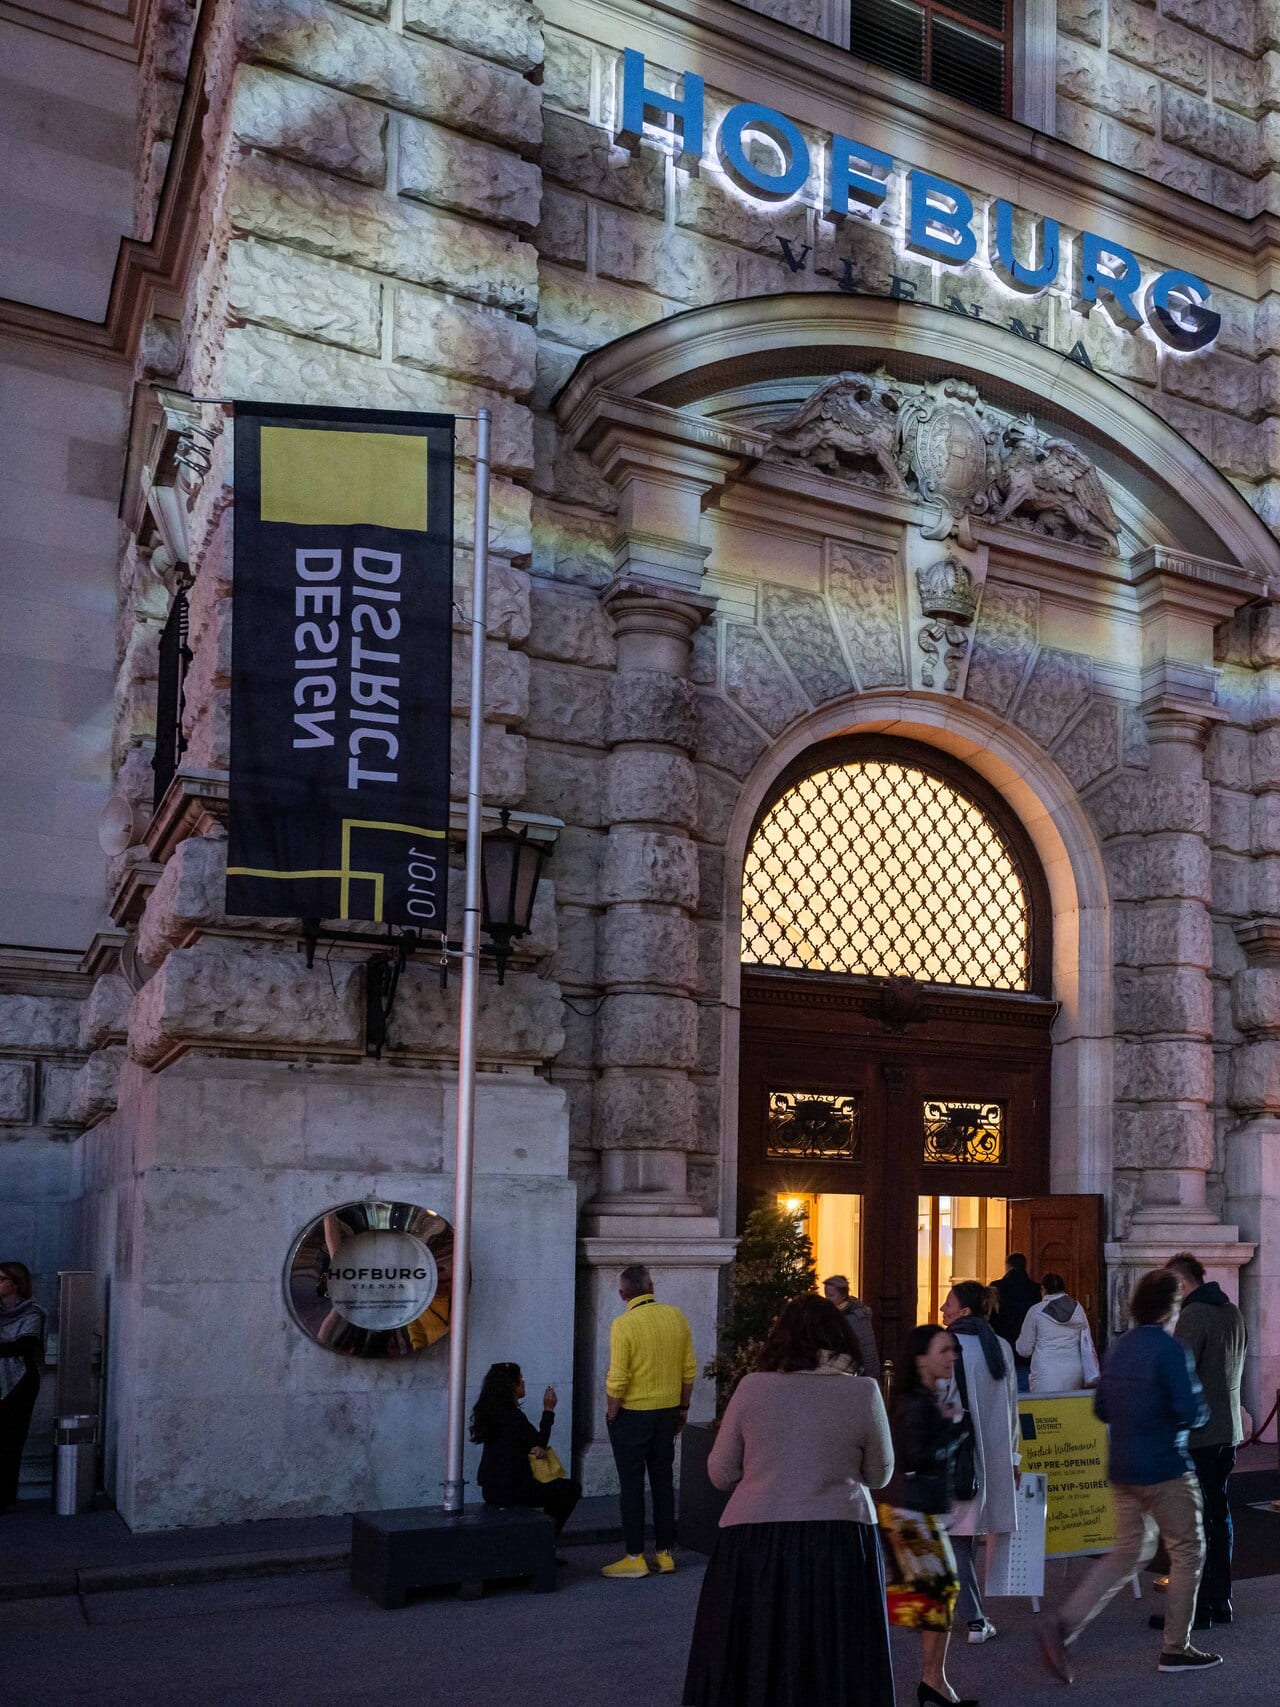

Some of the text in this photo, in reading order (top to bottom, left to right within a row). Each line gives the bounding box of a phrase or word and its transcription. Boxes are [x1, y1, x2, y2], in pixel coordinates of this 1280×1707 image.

[613, 46, 1221, 352] HOFBURG
[775, 234, 1095, 371] VIENNA
[328, 1267, 427, 1280] HOFBURG
[1036, 1423, 1062, 1431] DISTRICT
[1027, 1457, 1101, 1470] VIP PRE-OPENING
